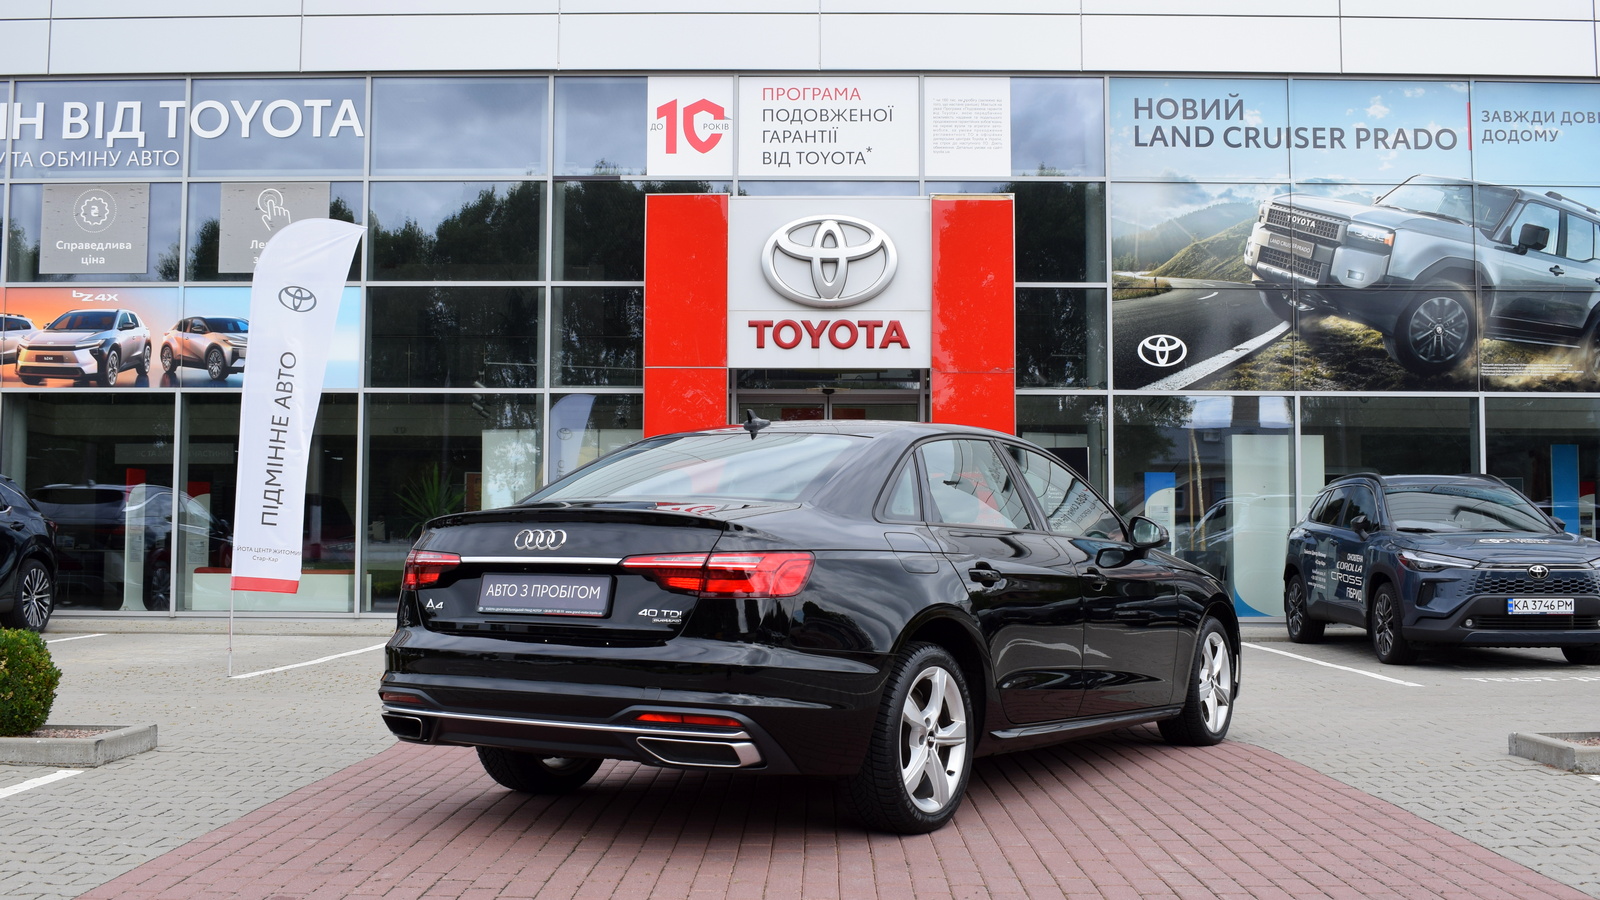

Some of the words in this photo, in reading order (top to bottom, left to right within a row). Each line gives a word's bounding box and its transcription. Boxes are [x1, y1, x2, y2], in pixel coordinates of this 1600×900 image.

[762, 88, 862, 101] ПРОГРАМА
[1134, 93, 1244, 120] НОВИЙ
[762, 105, 894, 125] ПОДОВЖЕНОЇ
[1481, 110, 1555, 125] ЗАВЖДИ
[1560, 111, 1600, 126] ДОВ
[62, 101, 146, 148] ВІД
[160, 99, 365, 139] TOYOTA
[650, 123, 664, 131] ДО
[703, 123, 730, 131] РОКІВ
[762, 127, 839, 144] ГАРАНТІЇ
[1134, 126, 1214, 148] LAND
[1223, 126, 1346, 149] CRUISER
[1356, 128, 1458, 151] PRADO
[1482, 129, 1559, 144] ДОДОМУ
[12, 152, 34, 167] ТА
[40, 151, 122, 167] ОБМІНУ
[126, 150, 180, 166] АВТО
[762, 151, 791, 168] ВІД
[1288, 215, 1316, 228] TOYOTA
[55, 240, 132, 252] Справедлива
[81, 254, 106, 265] ціна
[748, 319, 910, 350] TOYOTA
[274, 351, 297, 410] АВТО
[261, 415, 290, 526] ПІДМІННЕ
[252, 555, 279, 563] Стар-Кар
[1336, 560, 1363, 573] COROLLA
[1330, 571, 1363, 586] CROSS
[486, 584, 517, 598] АВТО
[531, 584, 601, 600] ПРОБІГОМ
[426, 598, 444, 610] A4
[1514, 600, 1529, 610] KA
[1532, 600, 1555, 610] 3746
[1557, 600, 1573, 610] PM
[638, 608, 657, 618] 40
[661, 610, 682, 619] TDI
